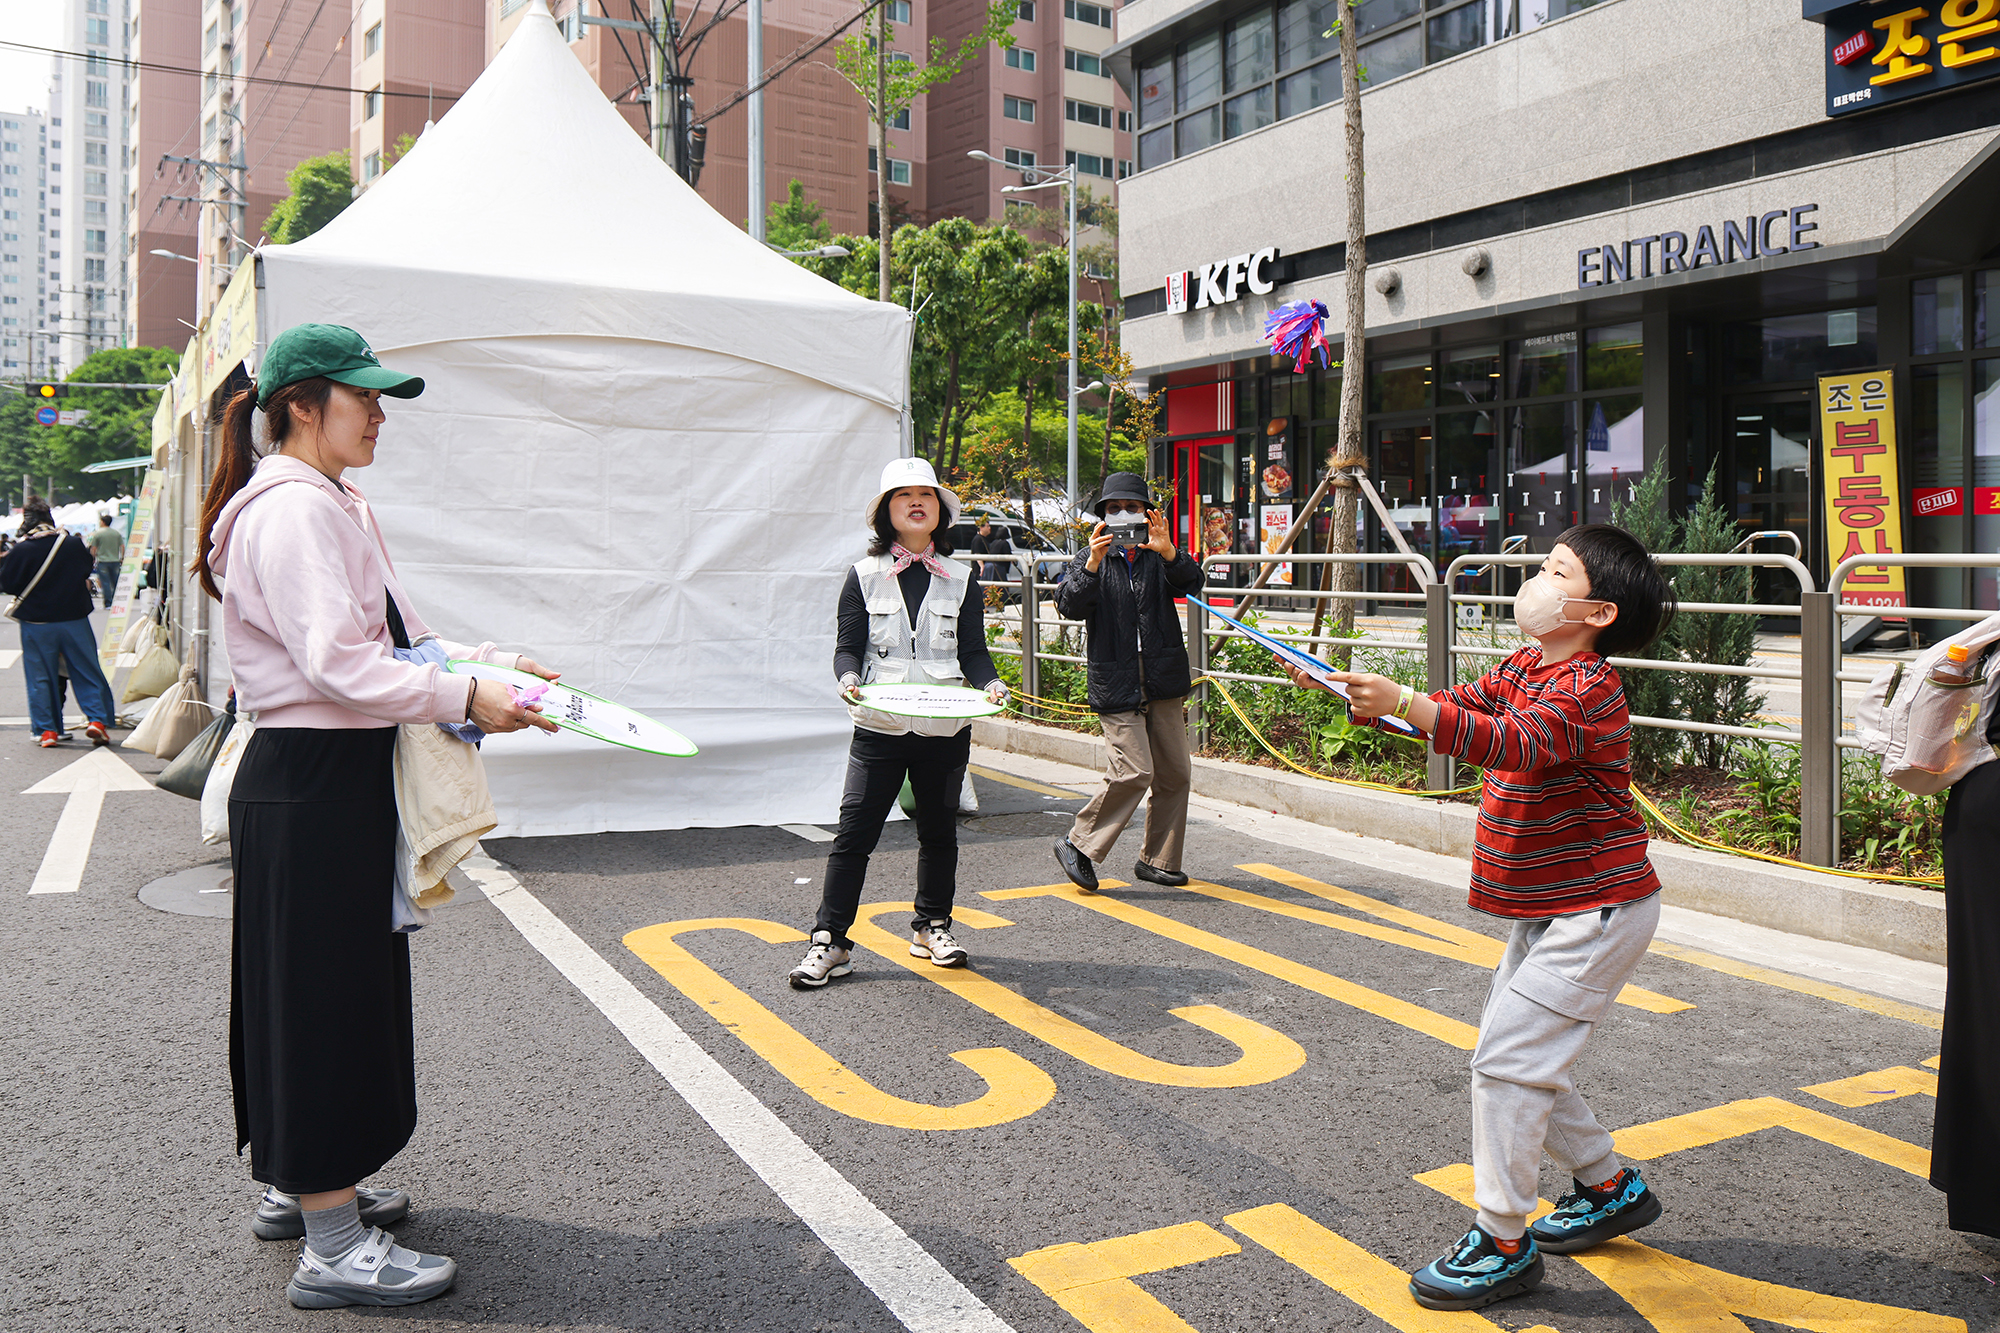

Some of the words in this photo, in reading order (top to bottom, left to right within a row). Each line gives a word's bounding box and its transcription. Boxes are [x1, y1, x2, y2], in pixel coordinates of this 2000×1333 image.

[1834, 33, 1865, 62] 단지내
[1195, 246, 1277, 310] KFC
[1578, 203, 1819, 289] ENTRANCE
[1827, 378, 1888, 413] 조은
[1831, 418, 1893, 584] 부동산
[1920, 492, 1954, 511] 단지내
[622, 864, 1696, 1130] CCTV
